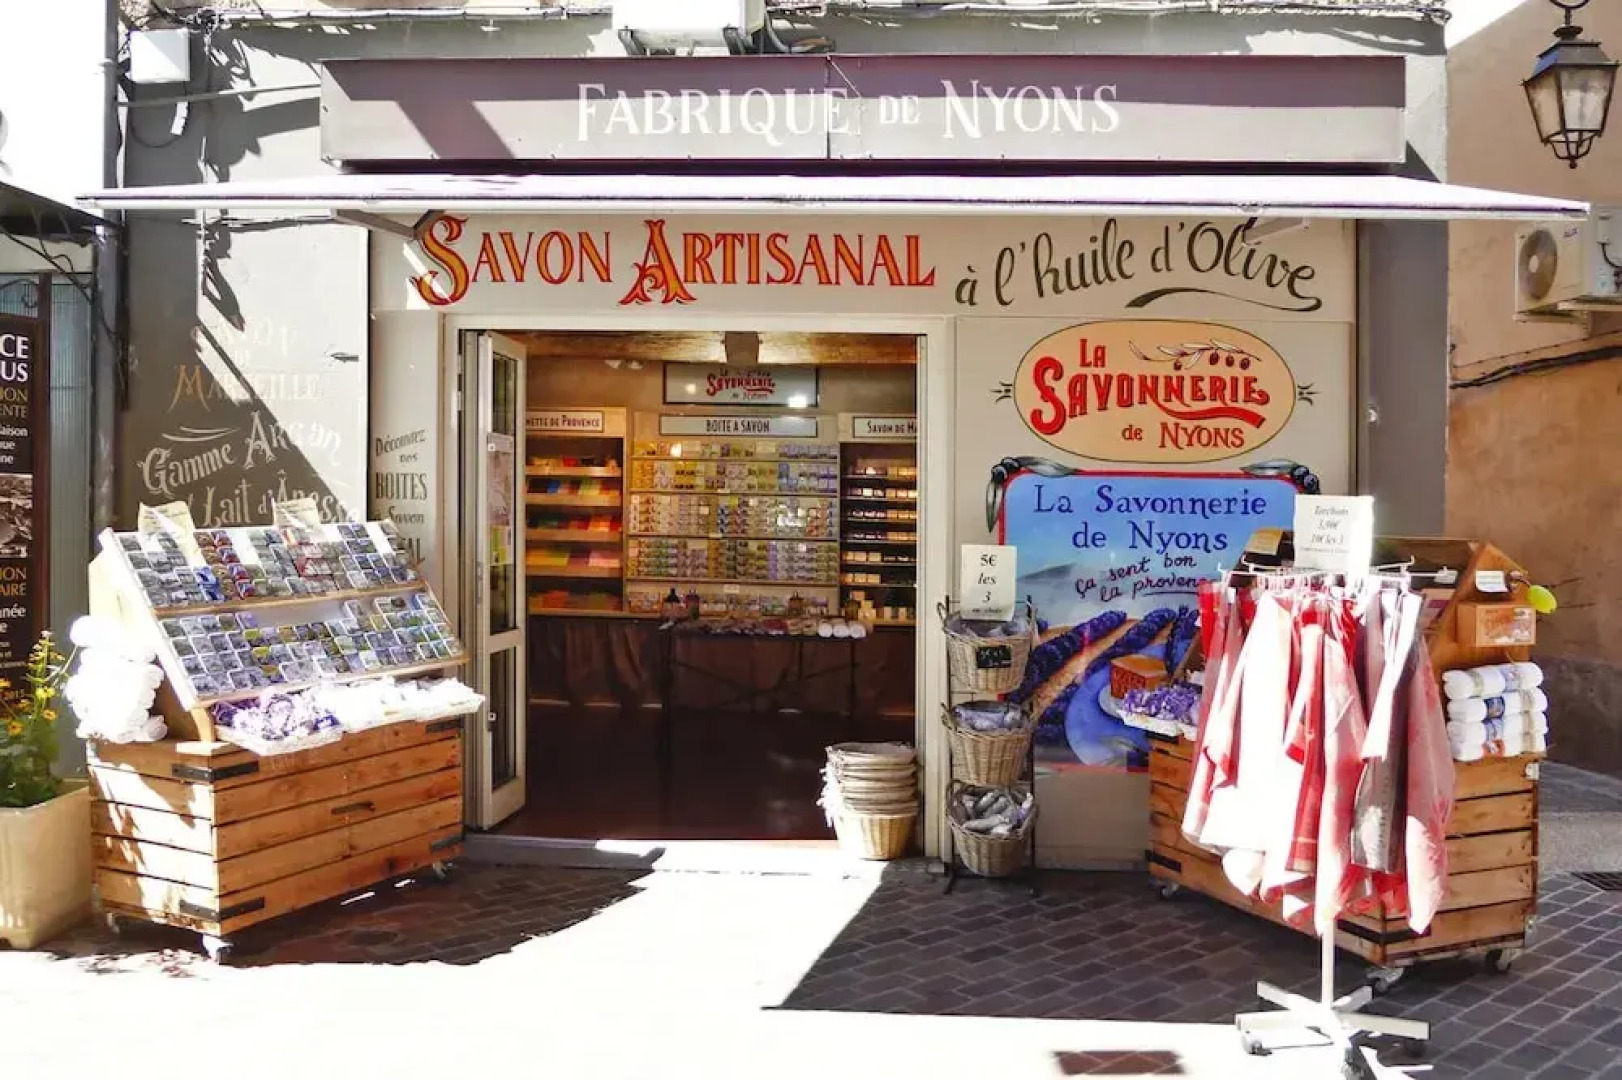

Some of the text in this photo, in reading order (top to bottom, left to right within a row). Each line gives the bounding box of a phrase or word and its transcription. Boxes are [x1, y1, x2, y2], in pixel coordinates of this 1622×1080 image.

[578, 79, 1120, 145] FABRIQUE DE NYONS
[410, 215, 936, 305] SAVON ARTISANAL
[955, 216, 1322, 312] à l'huile d'Olive
[1079, 339, 1106, 368] LA
[1030, 356, 1271, 435] SAVONNERIE
[1122, 422, 1246, 449] de NYONS
[137, 443, 237, 500] Gamme
[375, 472, 428, 500] BOITES
[1034, 484, 1268, 520] La Savonnerie
[1072, 520, 1229, 555] de Nyons
[980, 554, 997, 566] 5€
[1075, 552, 1198, 599] ça sent bon
[978, 572, 997, 585] les
[1100, 586, 1126, 602] la
[983, 591, 992, 603] 3
